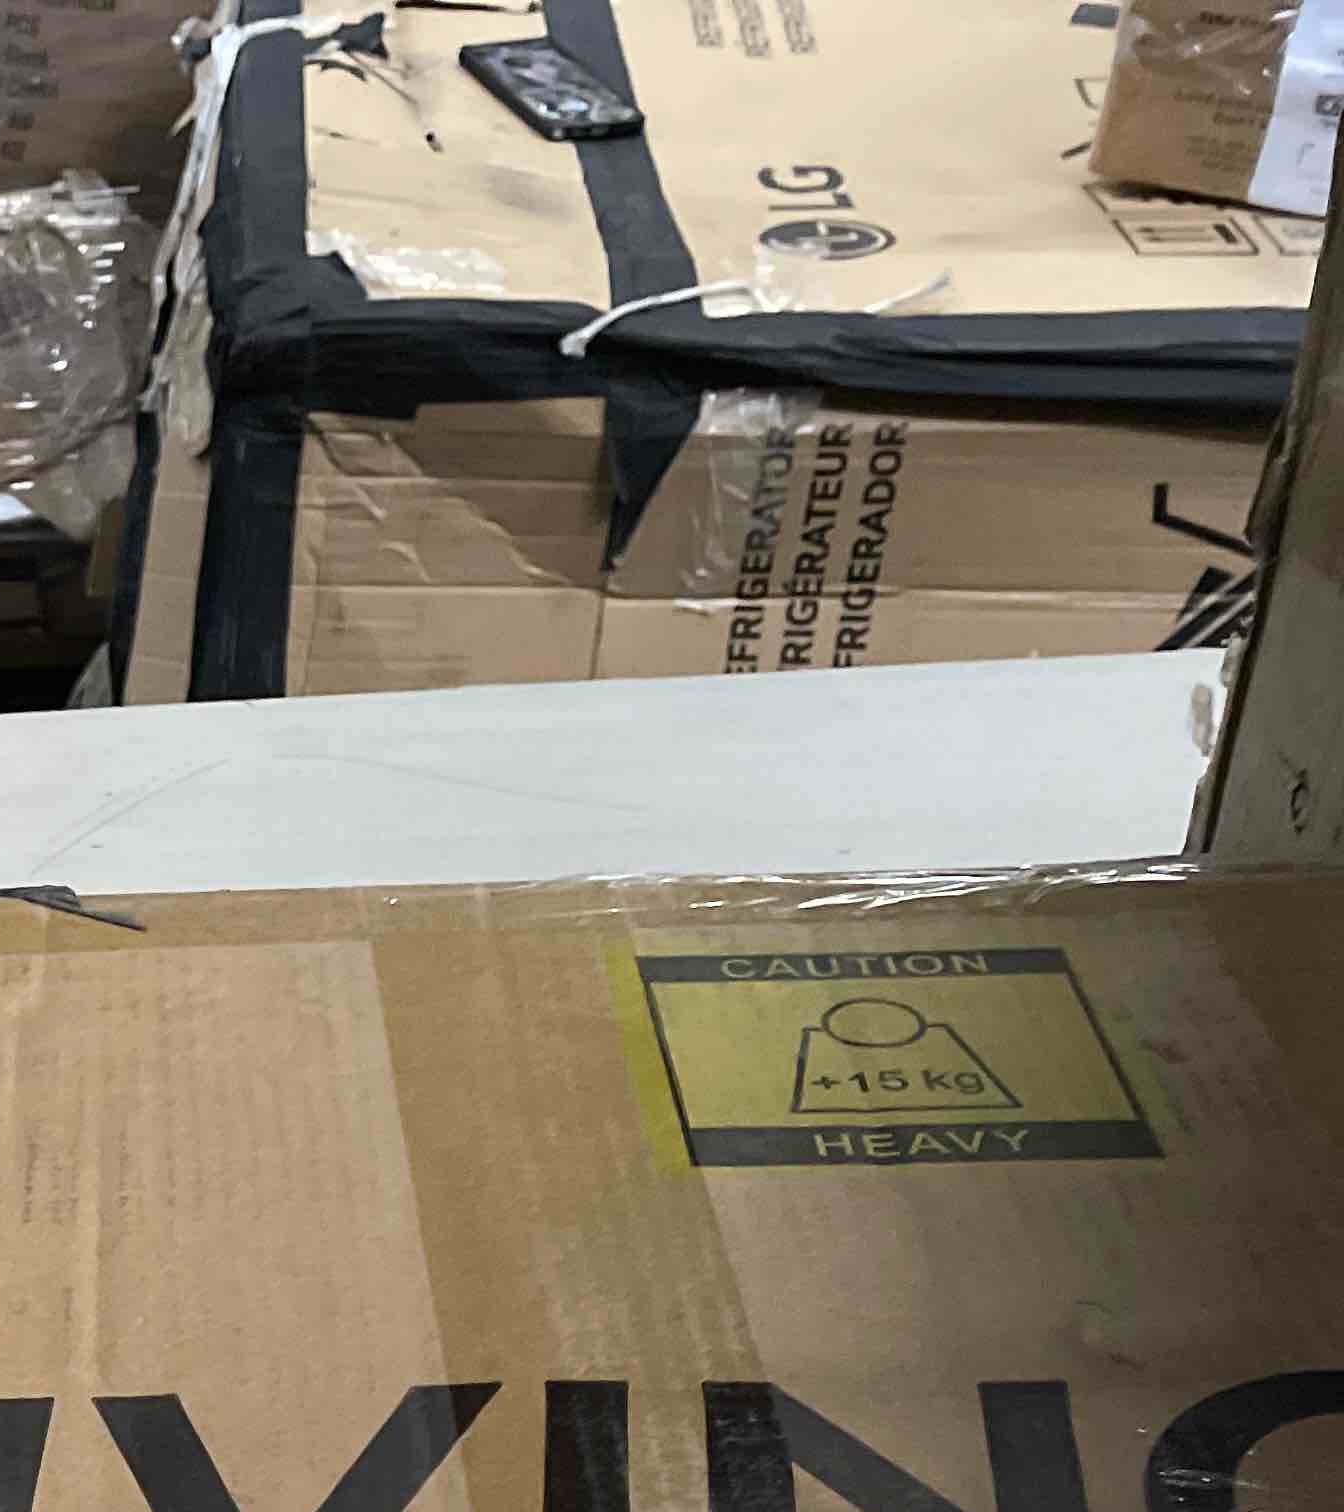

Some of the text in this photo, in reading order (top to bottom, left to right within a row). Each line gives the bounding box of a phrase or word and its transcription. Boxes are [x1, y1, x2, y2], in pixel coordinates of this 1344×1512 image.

[758, 163, 855, 212] LG
[777, 423, 854, 671] RIGÉRATEUR
[720, 953, 990, 980] CAUTION
[811, 1067, 986, 1096] +15 kg
[811, 1127, 1031, 1159] HEAVY
